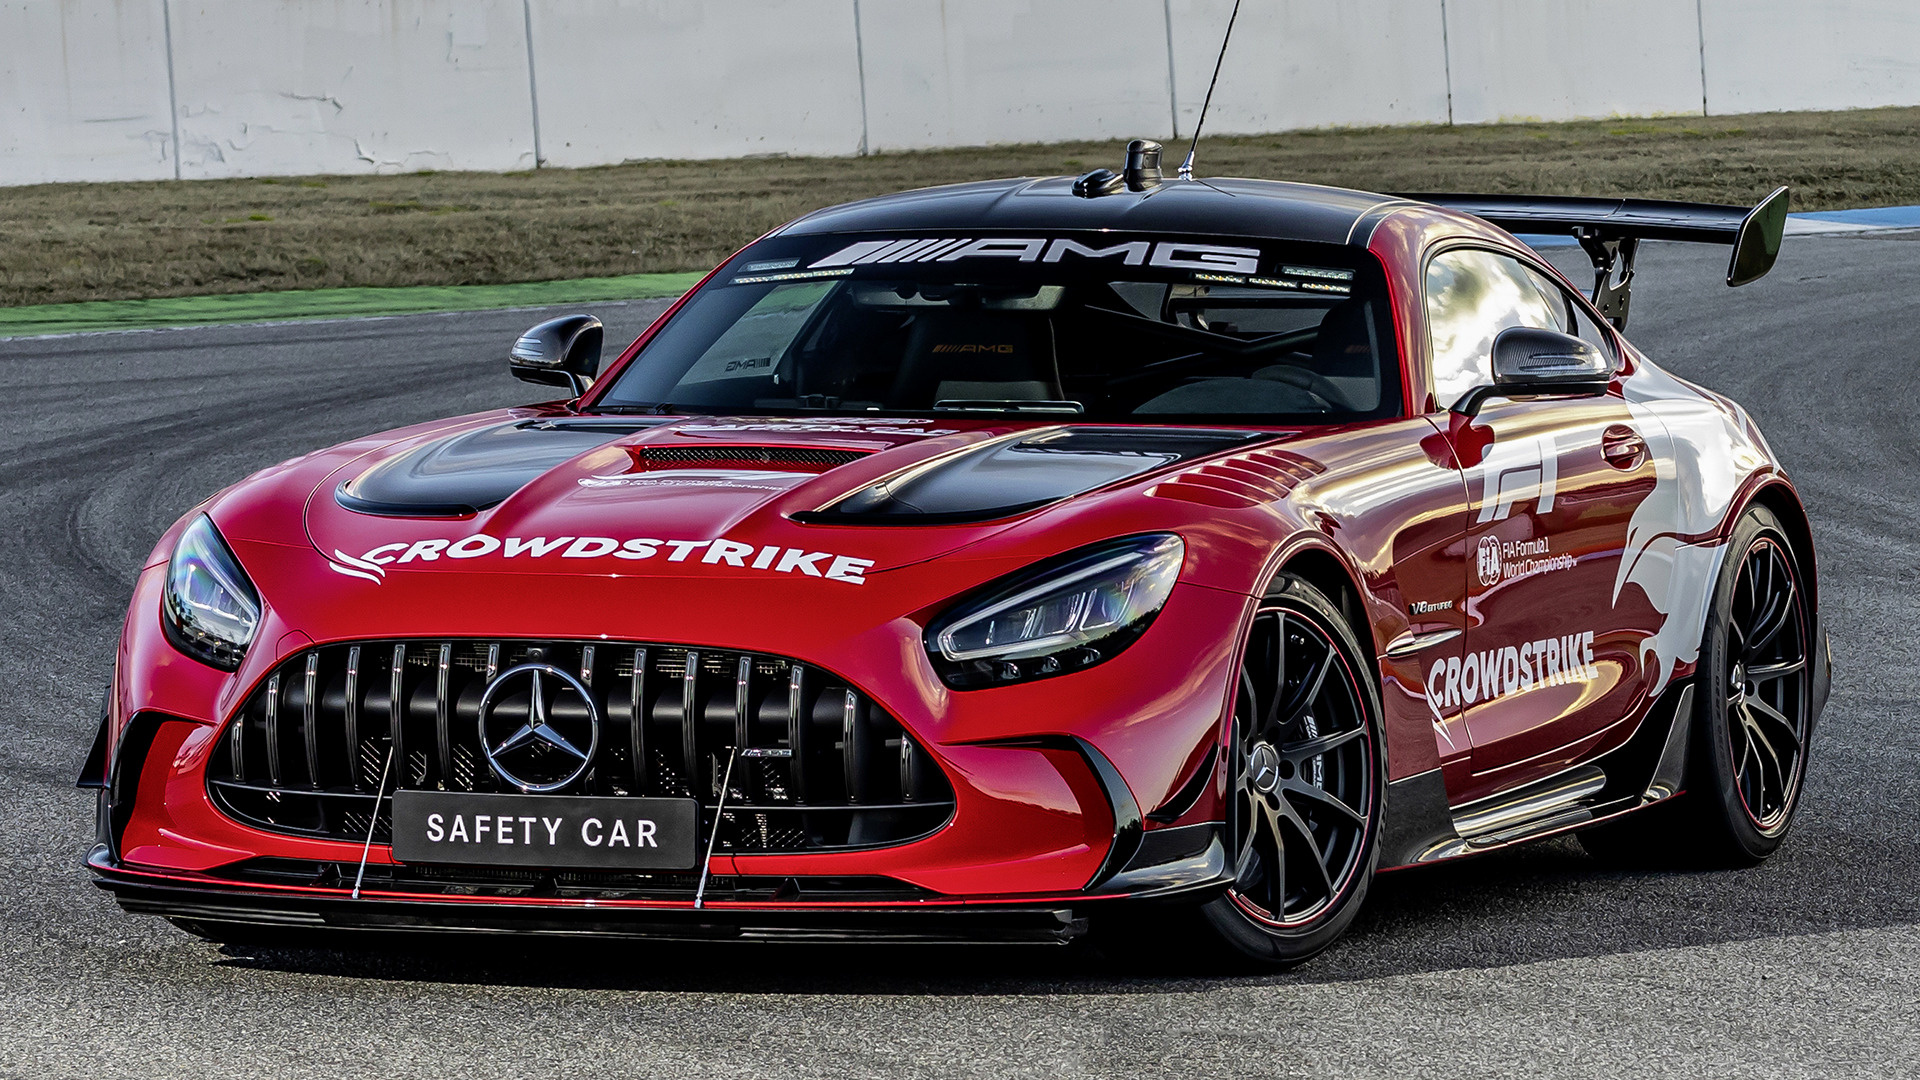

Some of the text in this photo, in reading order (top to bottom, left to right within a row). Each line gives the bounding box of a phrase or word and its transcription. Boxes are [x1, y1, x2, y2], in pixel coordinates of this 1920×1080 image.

[937, 238, 1261, 273] AMG
[959, 344, 1014, 354] AMG
[359, 533, 876, 585] CROWDSTRIKE
[1502, 542, 1515, 559] FIA
[1503, 552, 1573, 579] World Championship
[1427, 630, 1598, 709] CROWDSTRIKE
[426, 813, 658, 848] SAFETY CAR
